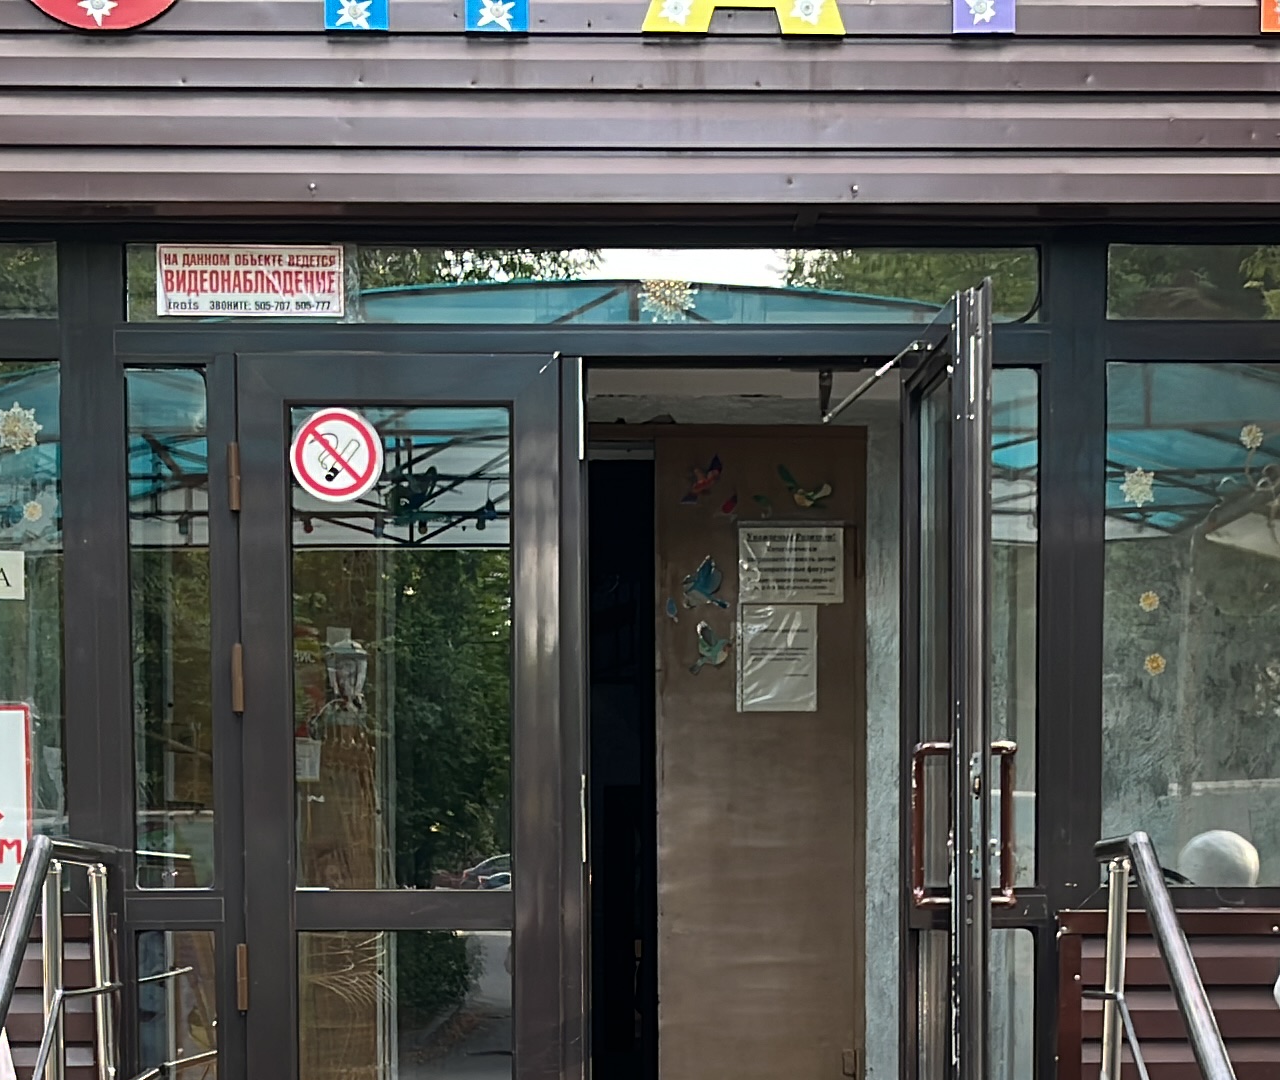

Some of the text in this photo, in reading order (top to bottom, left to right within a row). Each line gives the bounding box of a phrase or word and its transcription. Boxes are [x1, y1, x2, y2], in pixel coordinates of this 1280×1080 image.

[164, 253, 336, 268] НА ДАННОМ ОБЪЕКТЕ ВЕДЕТСЯ
[164, 269, 336, 297] ВИДЕОНАБЛЮДЕНИЕ
[209, 300, 252, 311] ЗВОНИТЕ:
